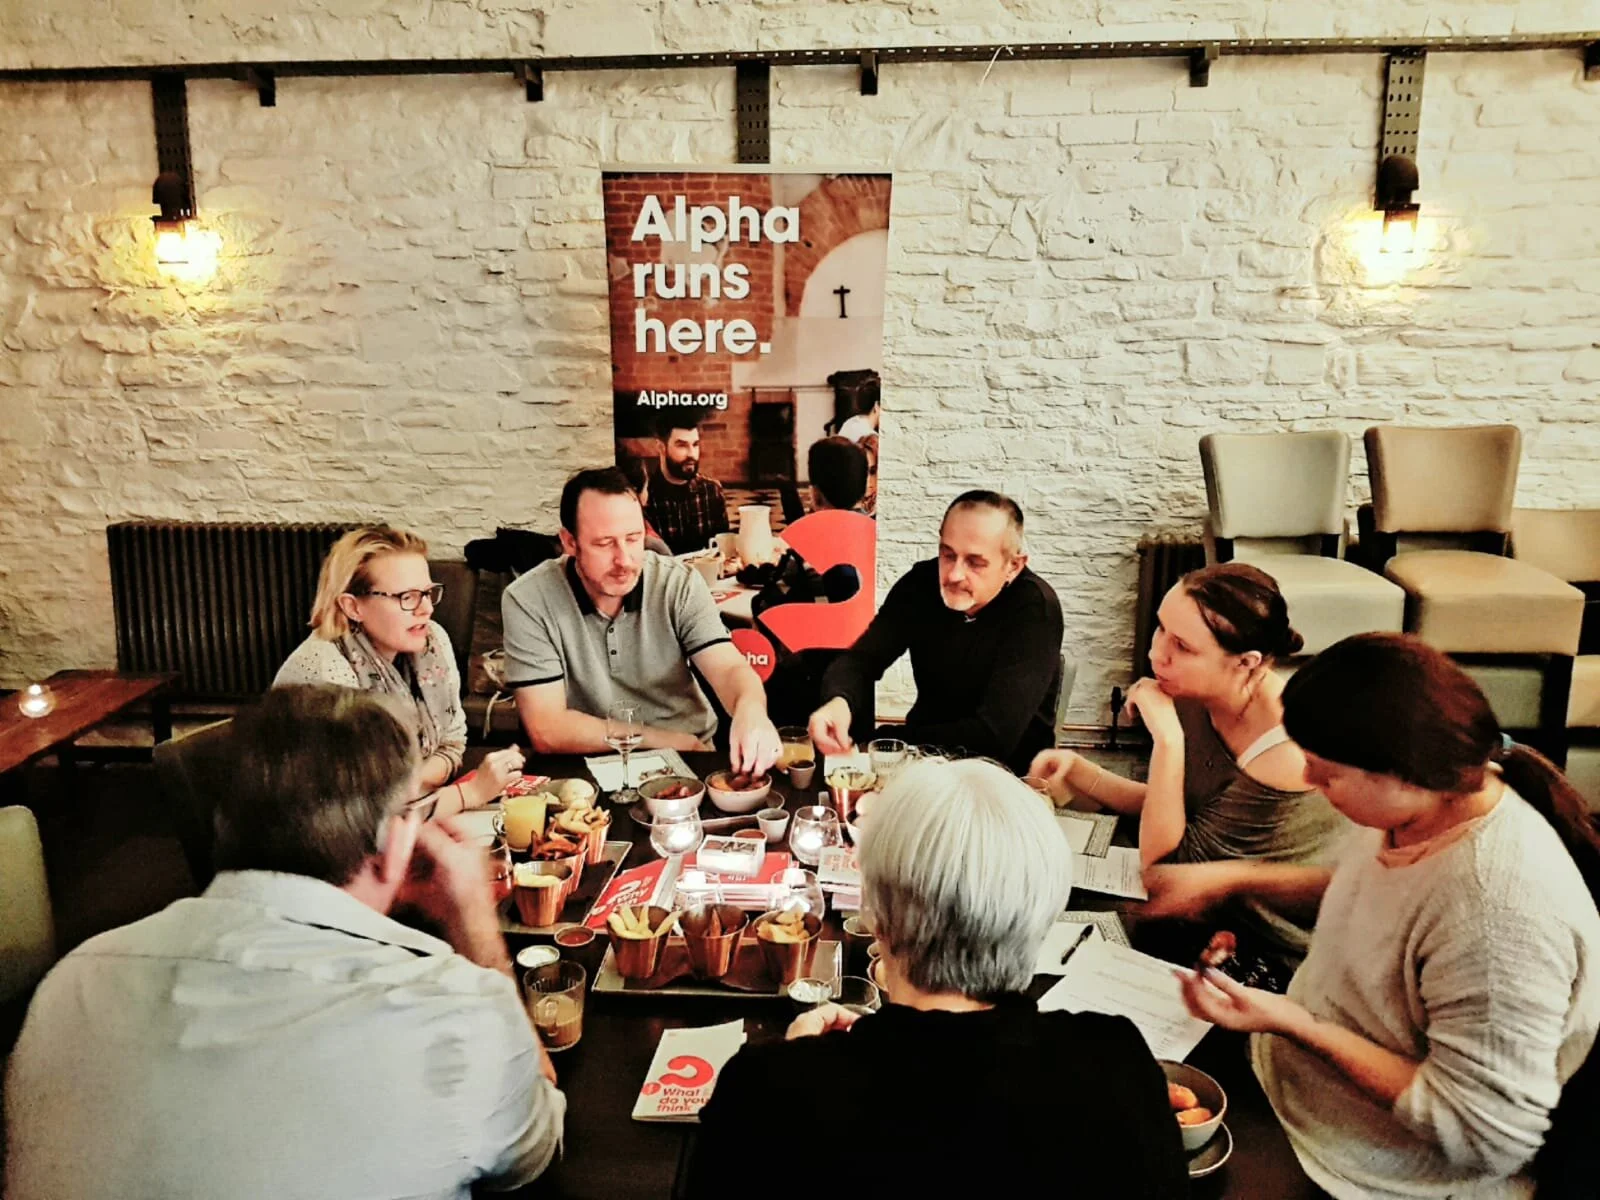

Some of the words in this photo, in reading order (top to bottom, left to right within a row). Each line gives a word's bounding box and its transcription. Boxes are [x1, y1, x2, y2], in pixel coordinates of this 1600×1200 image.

[631, 194, 800, 253] Alpha
[633, 263, 750, 299] runs
[635, 308, 772, 354] here.
[637, 390, 729, 410] Alpha.org
[659, 1096, 679, 1105] do
[663, 1088, 700, 1096] What
[656, 1104, 692, 1112] think
